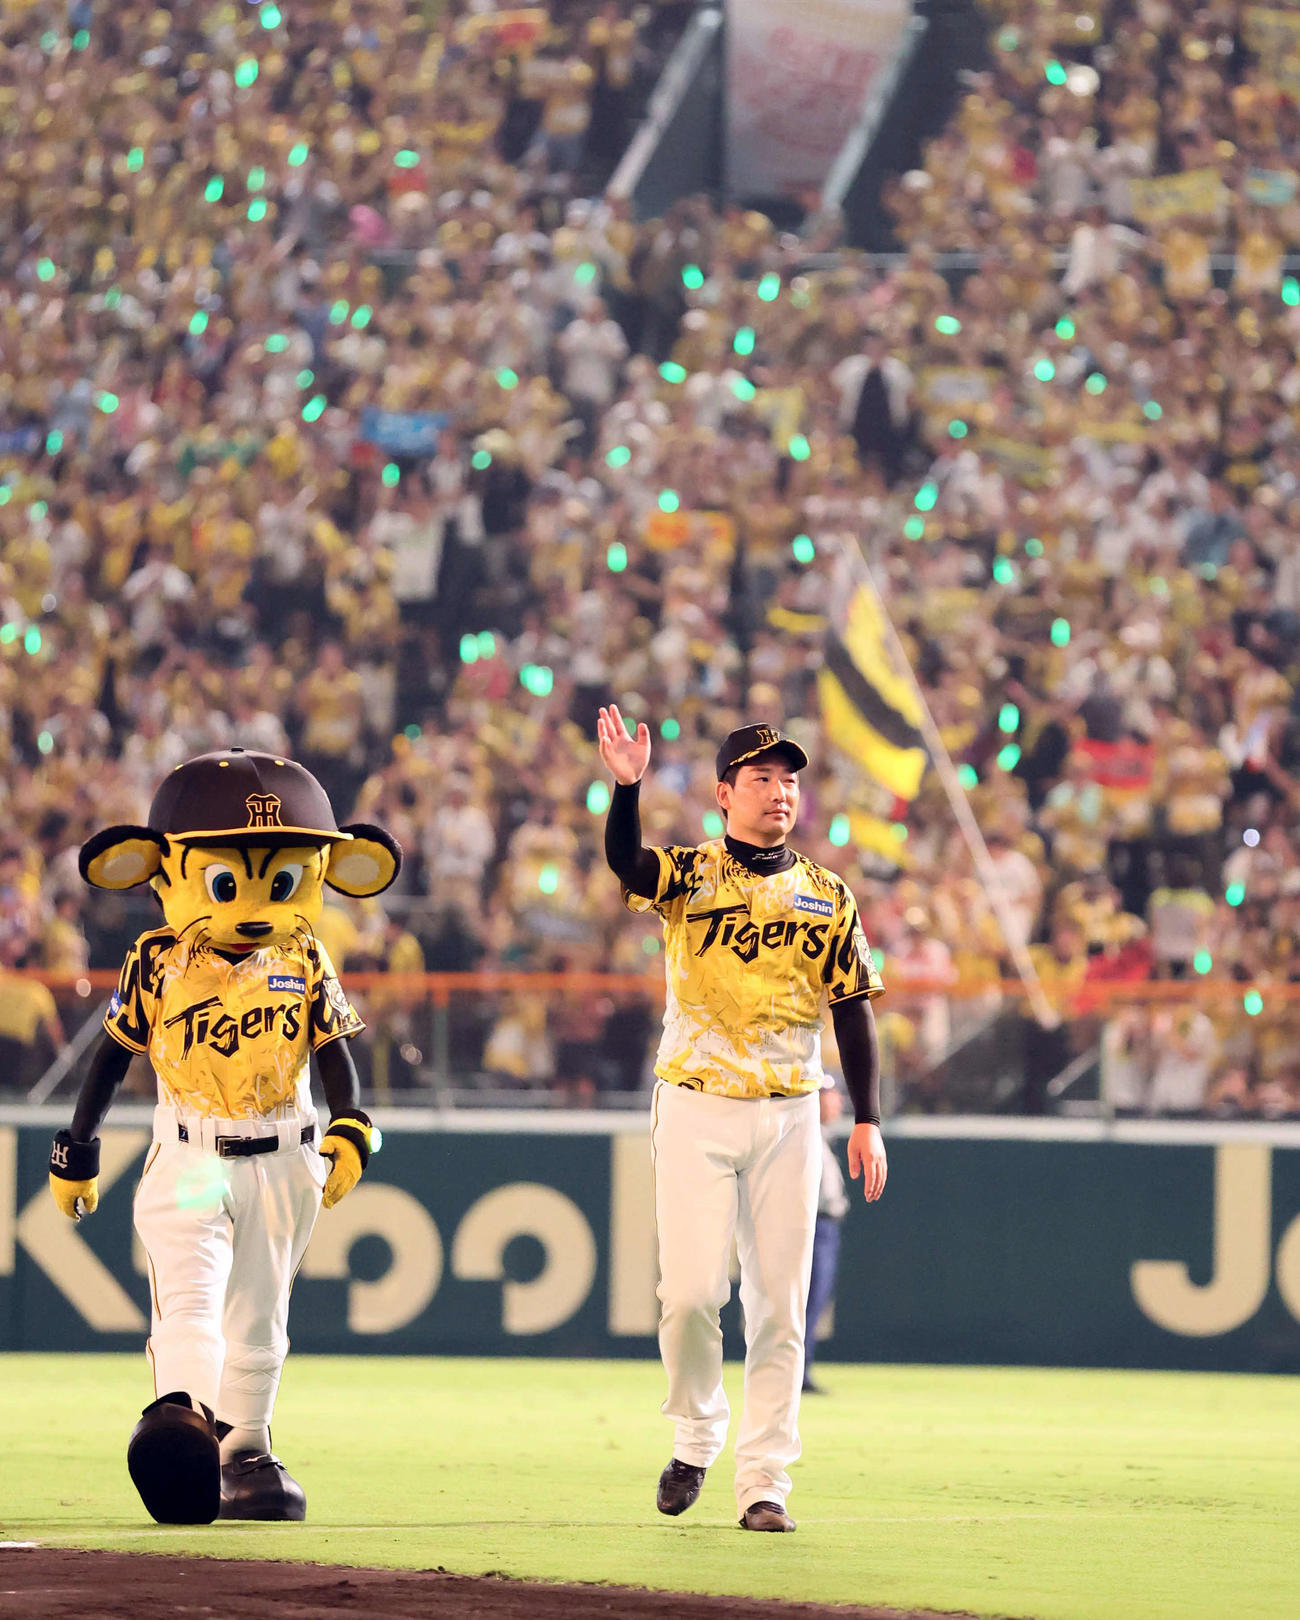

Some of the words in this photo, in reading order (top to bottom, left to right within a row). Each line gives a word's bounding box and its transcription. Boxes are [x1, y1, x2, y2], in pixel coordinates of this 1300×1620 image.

[686, 903, 831, 965] Tigers
[794, 897, 833, 914] Joshin
[269, 978, 305, 991] Joshin
[163, 995, 303, 1061] Tigers
[1130, 1142, 1300, 1338] J
